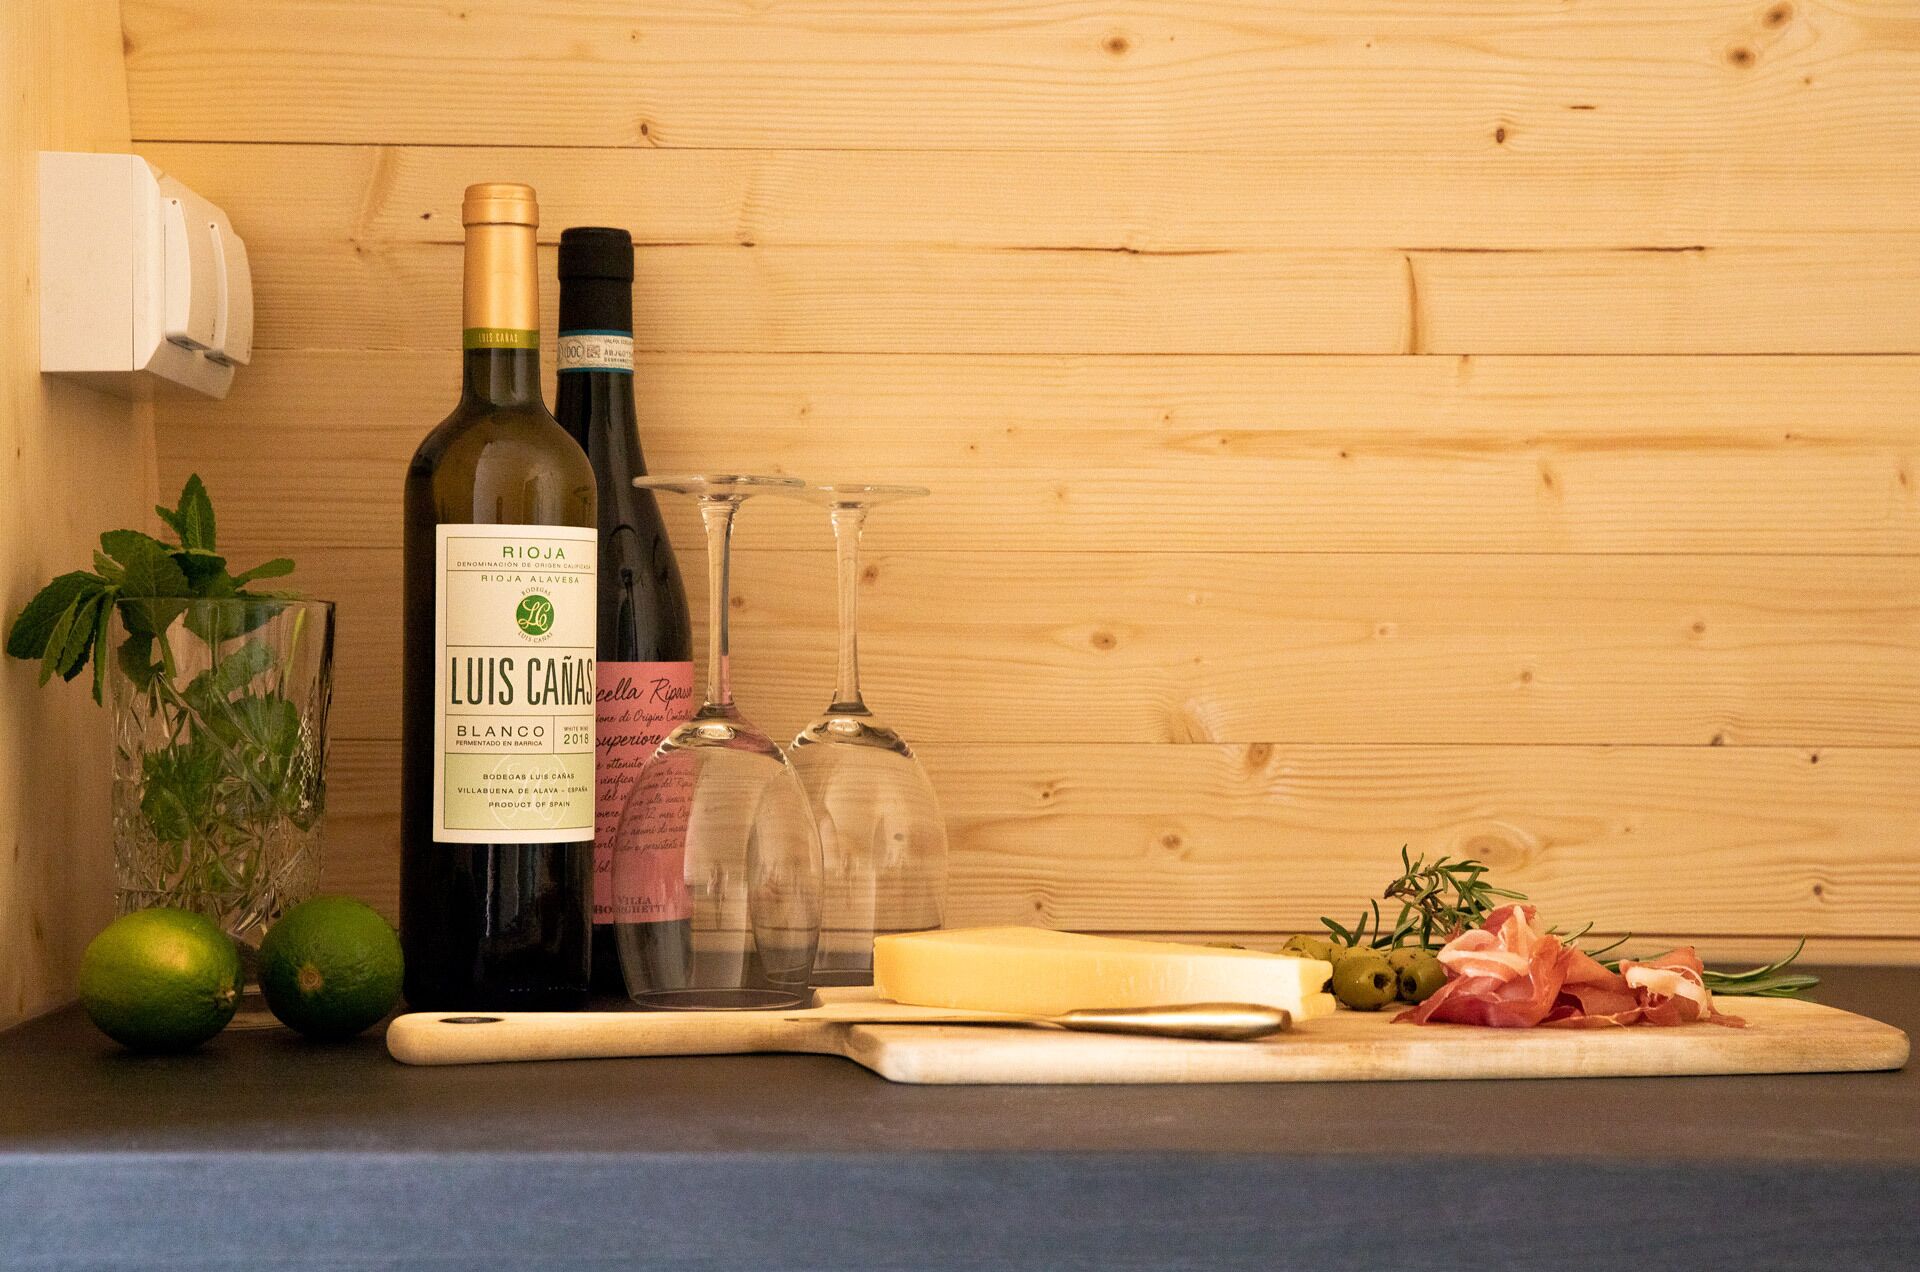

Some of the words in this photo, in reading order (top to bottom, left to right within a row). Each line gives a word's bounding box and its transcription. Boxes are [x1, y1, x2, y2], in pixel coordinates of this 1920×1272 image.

[502, 546, 566, 559] RIOJA
[481, 574, 522, 583] RIOJA
[530, 575, 580, 584] ALAVESA
[451, 657, 514, 706] LUIS
[527, 655, 593, 706] CAÑAS
[596, 677, 644, 702] cella
[633, 709, 664, 727] Origine
[457, 726, 544, 737] BLANCO
[563, 733, 589, 744] 2018
[551, 772, 575, 780] CAÑAS
